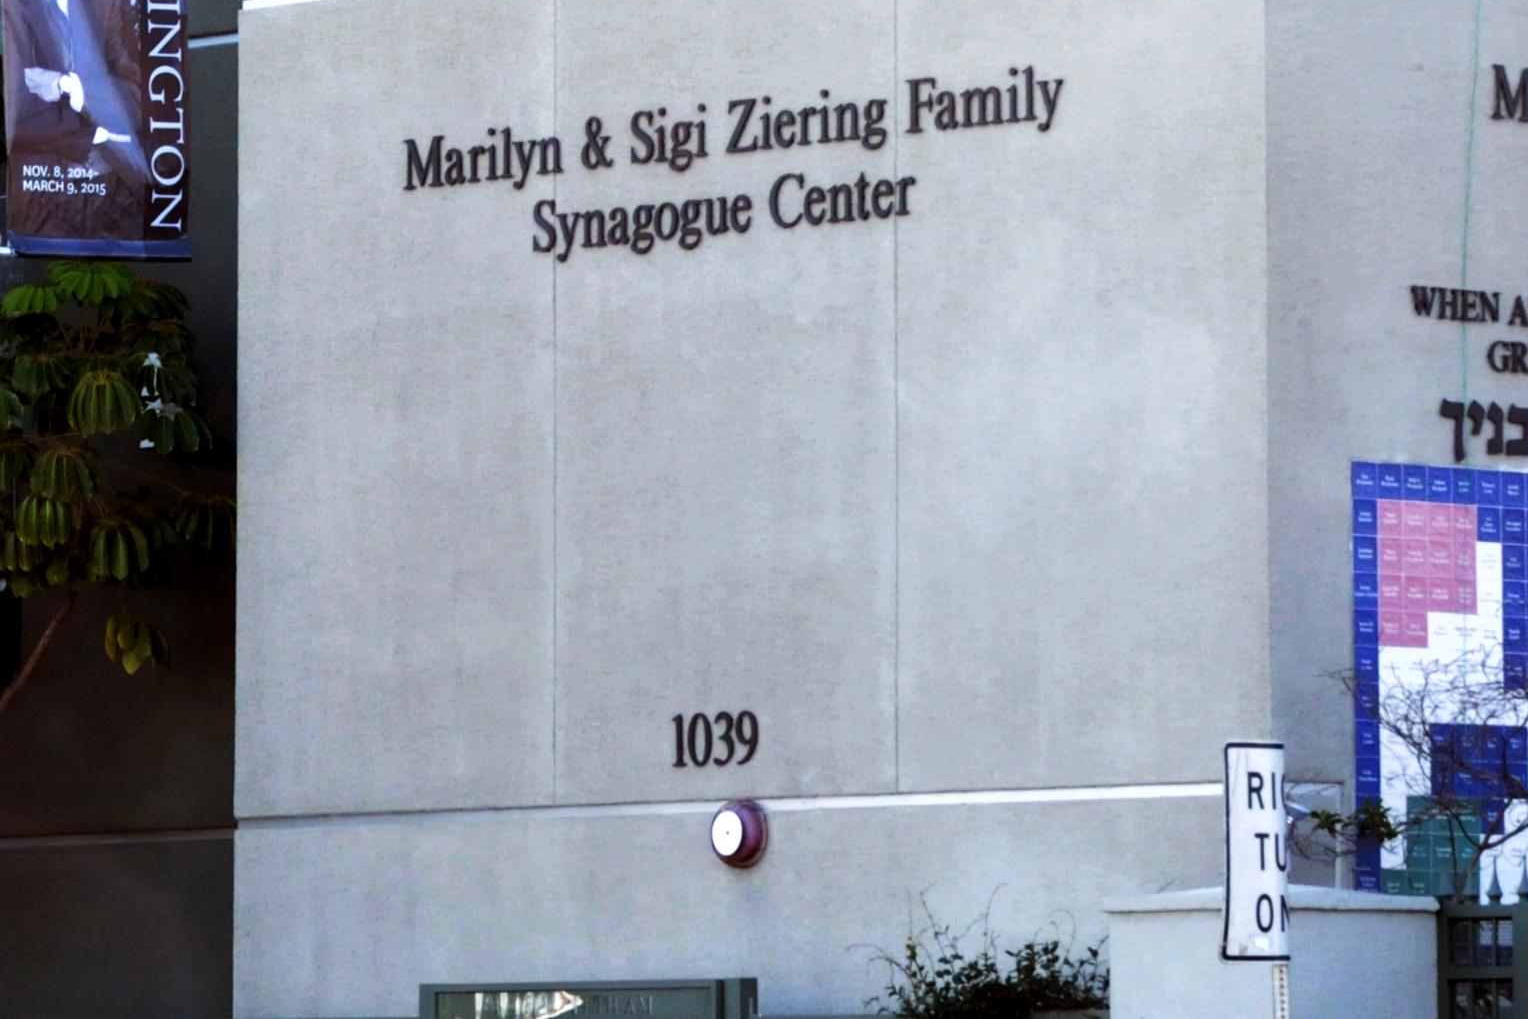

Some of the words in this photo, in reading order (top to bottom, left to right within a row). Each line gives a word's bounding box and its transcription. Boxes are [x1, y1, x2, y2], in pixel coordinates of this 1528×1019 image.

[402, 127, 564, 192] Marilyn
[581, 116, 613, 171] &
[629, 103, 708, 173] Sigi
[724, 88, 888, 153] Ziering
[905, 66, 1064, 135] Family
[22, 165, 50, 177] NOV.
[53, 165, 64, 179] 8,
[67, 168, 99, 180] 2014-
[22, 180, 64, 192] MARCH
[67, 182, 78, 195] 9,
[81, 183, 106, 196] 2015
[532, 186, 753, 263] Synagogue
[768, 170, 917, 230] Center
[1411, 285, 1500, 323] WHEN
[671, 710, 760, 768] 1039
[1247, 772, 1286, 810] RI
